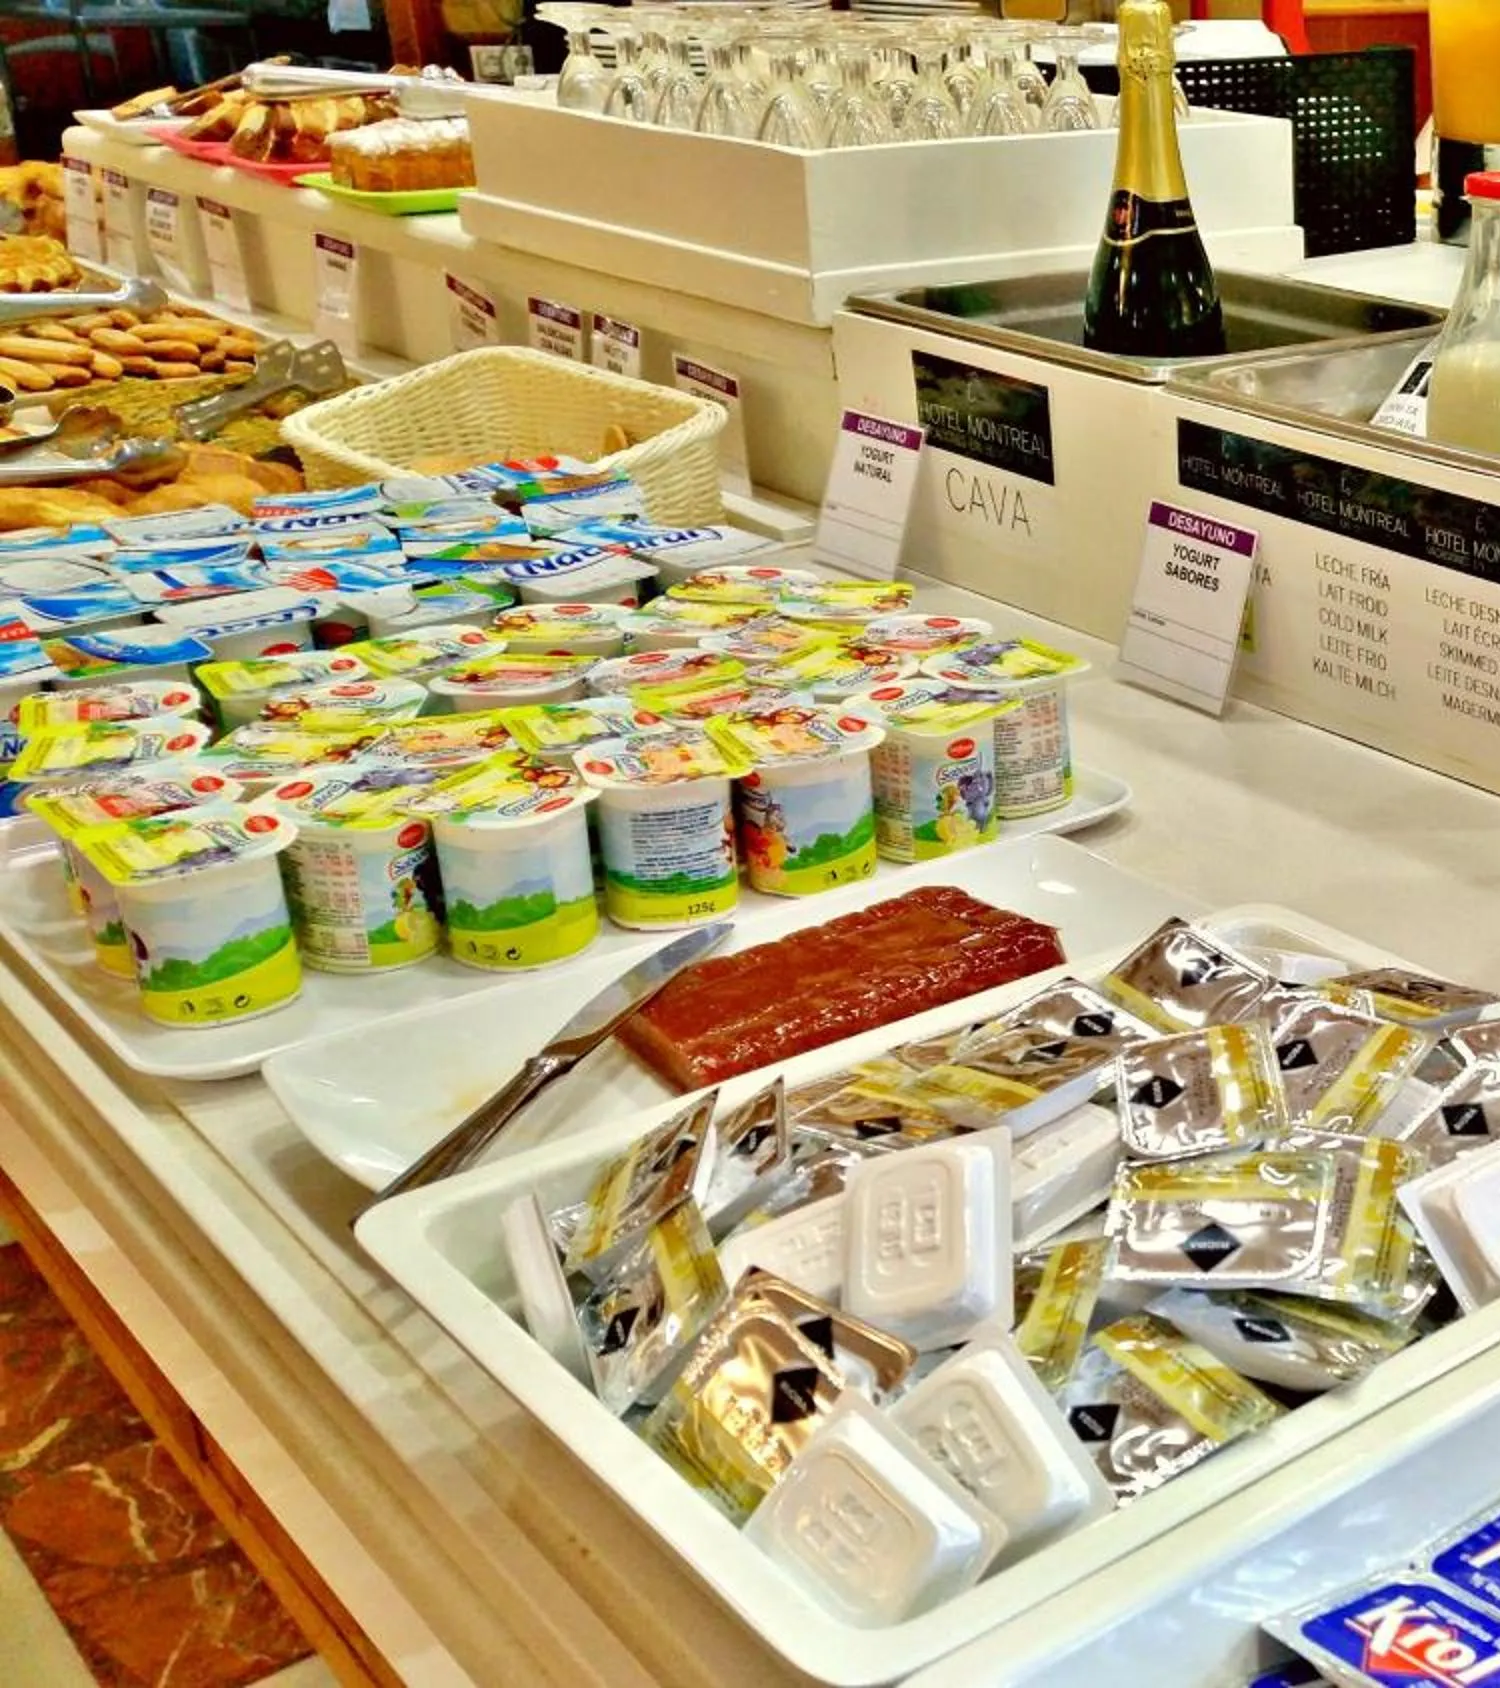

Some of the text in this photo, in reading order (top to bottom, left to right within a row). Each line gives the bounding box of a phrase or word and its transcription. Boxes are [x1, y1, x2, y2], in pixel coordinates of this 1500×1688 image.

[857, 418, 907, 444] DESAYUNO
[919, 401, 964, 433] HOTEL
[968, 415, 1049, 460] MONTREAL
[861, 445, 895, 465] YOGURT
[853, 461, 892, 483] NATURAL
[1182, 455, 1285, 499] HOTEL MONTREAL
[945, 468, 1032, 536] CAVA
[1168, 511, 1236, 547] DESAYUNO
[1339, 500, 1410, 538] MONTREAL
[1172, 544, 1221, 570] YOGURT
[1424, 527, 1469, 556] HOTEL
[1165, 562, 1220, 593] SABORES
[1315, 552, 1357, 582] LECHE
[1318, 580, 1388, 617] LAIT FROID
[1424, 586, 1467, 613] LECHE
[1318, 608, 1389, 644] COLD MILK
[1443, 618, 1471, 642] LAIT
[1319, 634, 1388, 671] LEITE FRIO
[1439, 641, 1498, 675] SKIMMED
[1313, 656, 1396, 700] KALTE MILCH
[1427, 662, 1461, 687] LEITE
